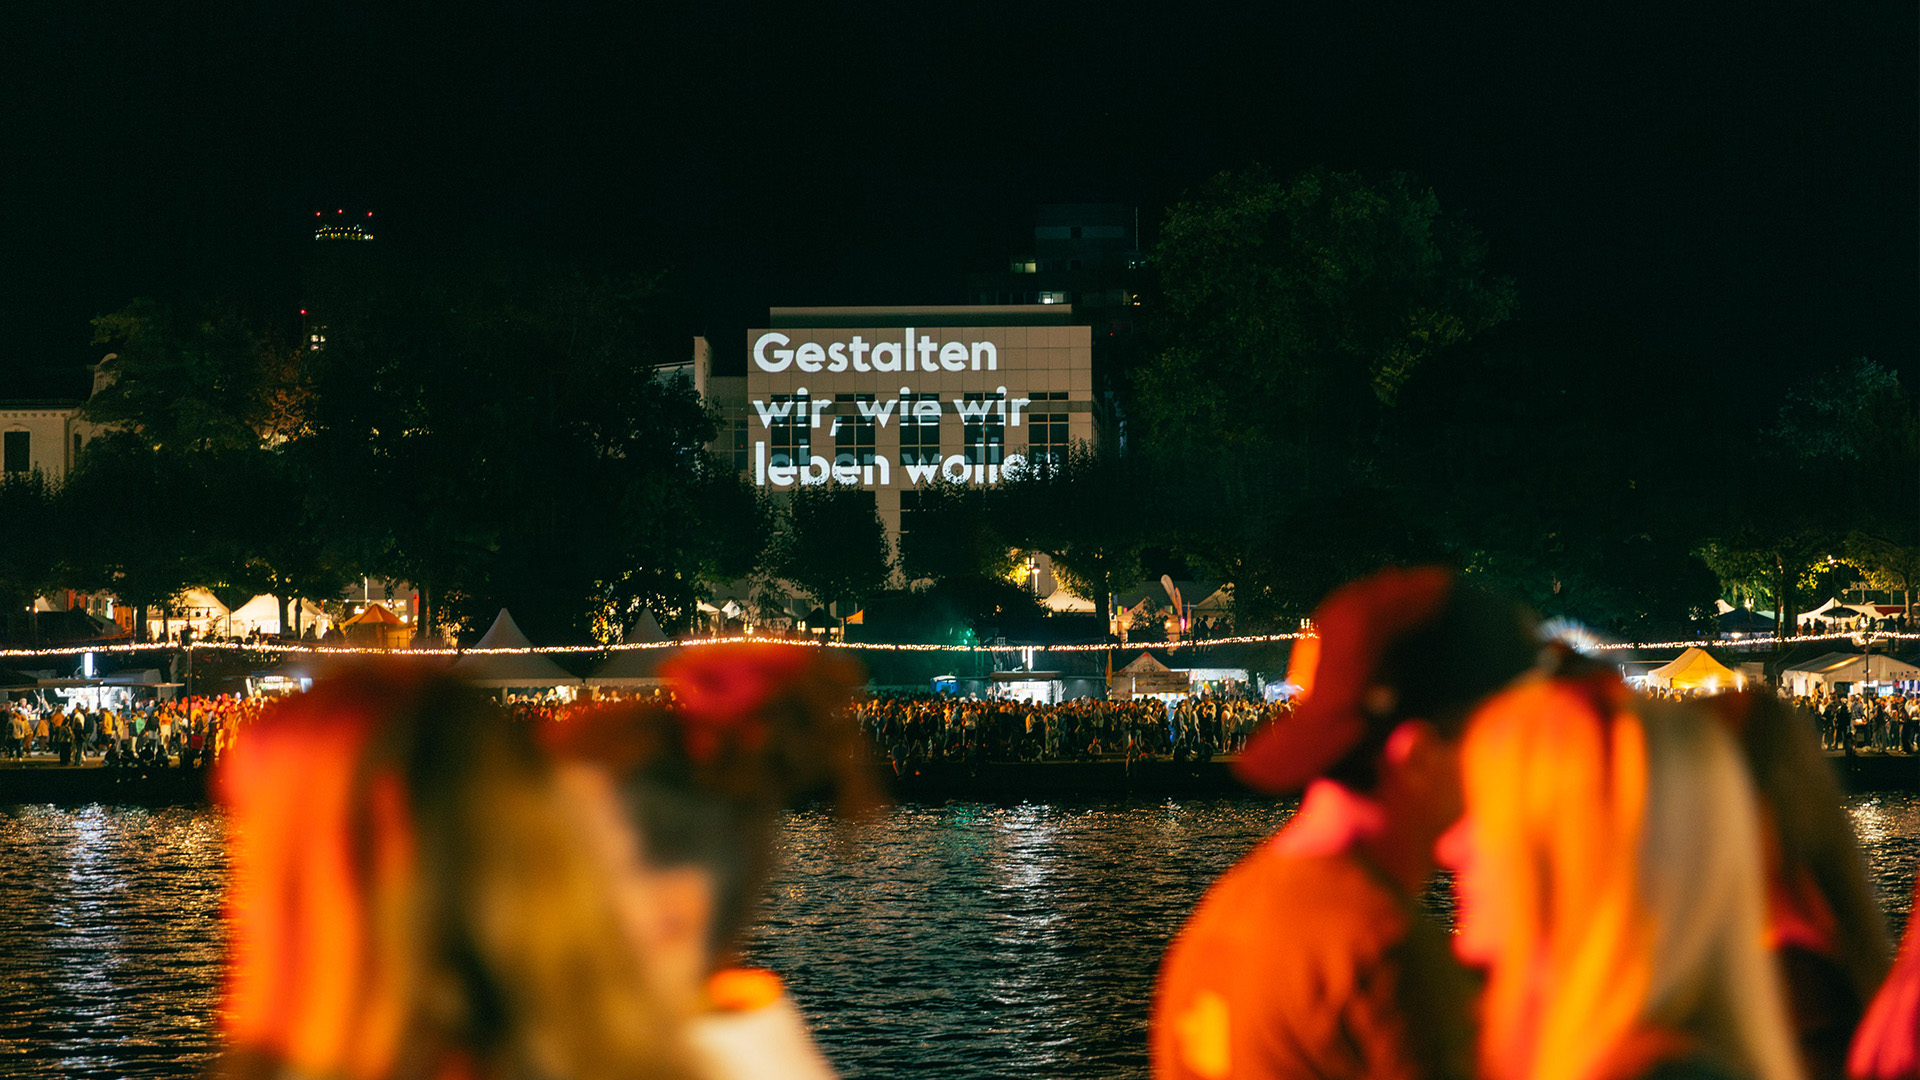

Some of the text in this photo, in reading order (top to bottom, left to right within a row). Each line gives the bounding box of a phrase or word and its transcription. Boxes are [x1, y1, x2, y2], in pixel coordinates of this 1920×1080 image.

[753, 327, 998, 373] Gestalten
[753, 385, 1032, 437] wir, wie wir
[755, 441, 890, 486] leben
